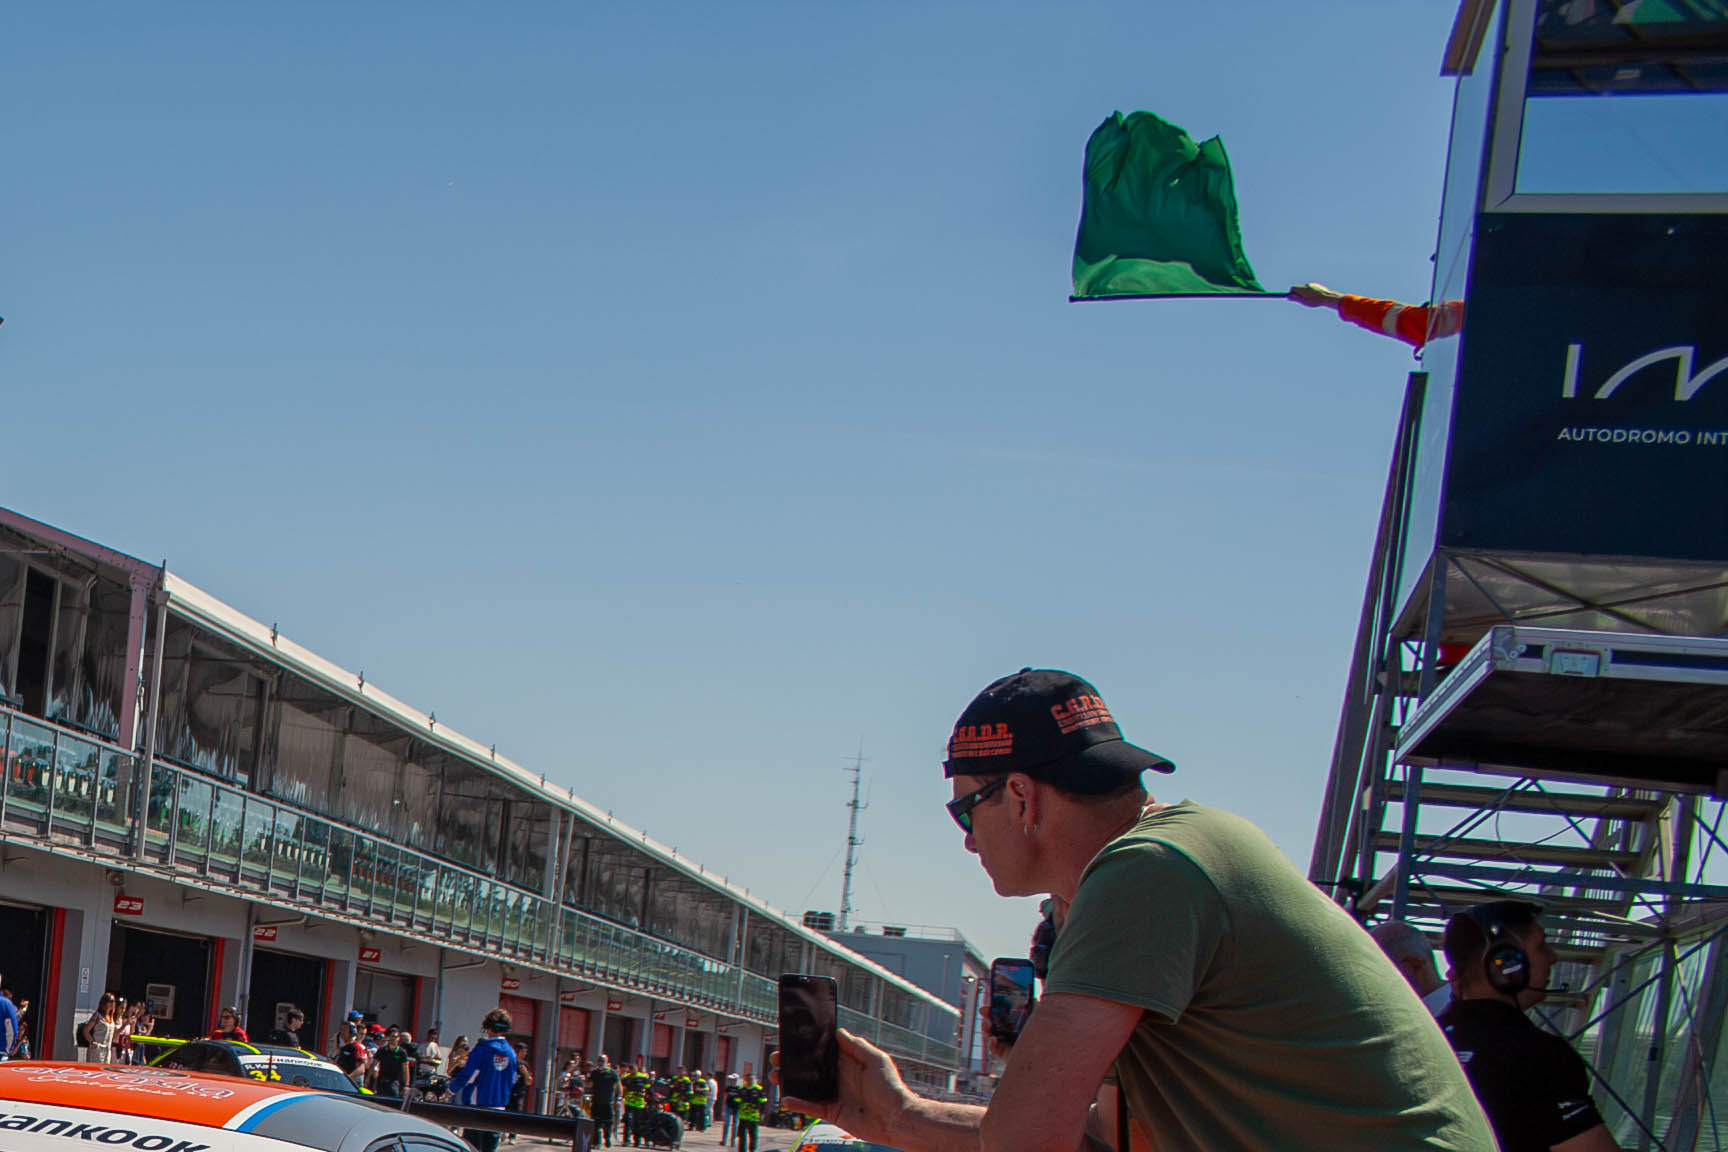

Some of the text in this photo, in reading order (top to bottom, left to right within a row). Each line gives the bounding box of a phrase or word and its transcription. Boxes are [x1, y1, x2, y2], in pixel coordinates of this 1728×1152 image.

[1557, 427, 1690, 444] AUTODROMO
[116, 899, 143, 912] 23
[253, 927, 276, 938] 22
